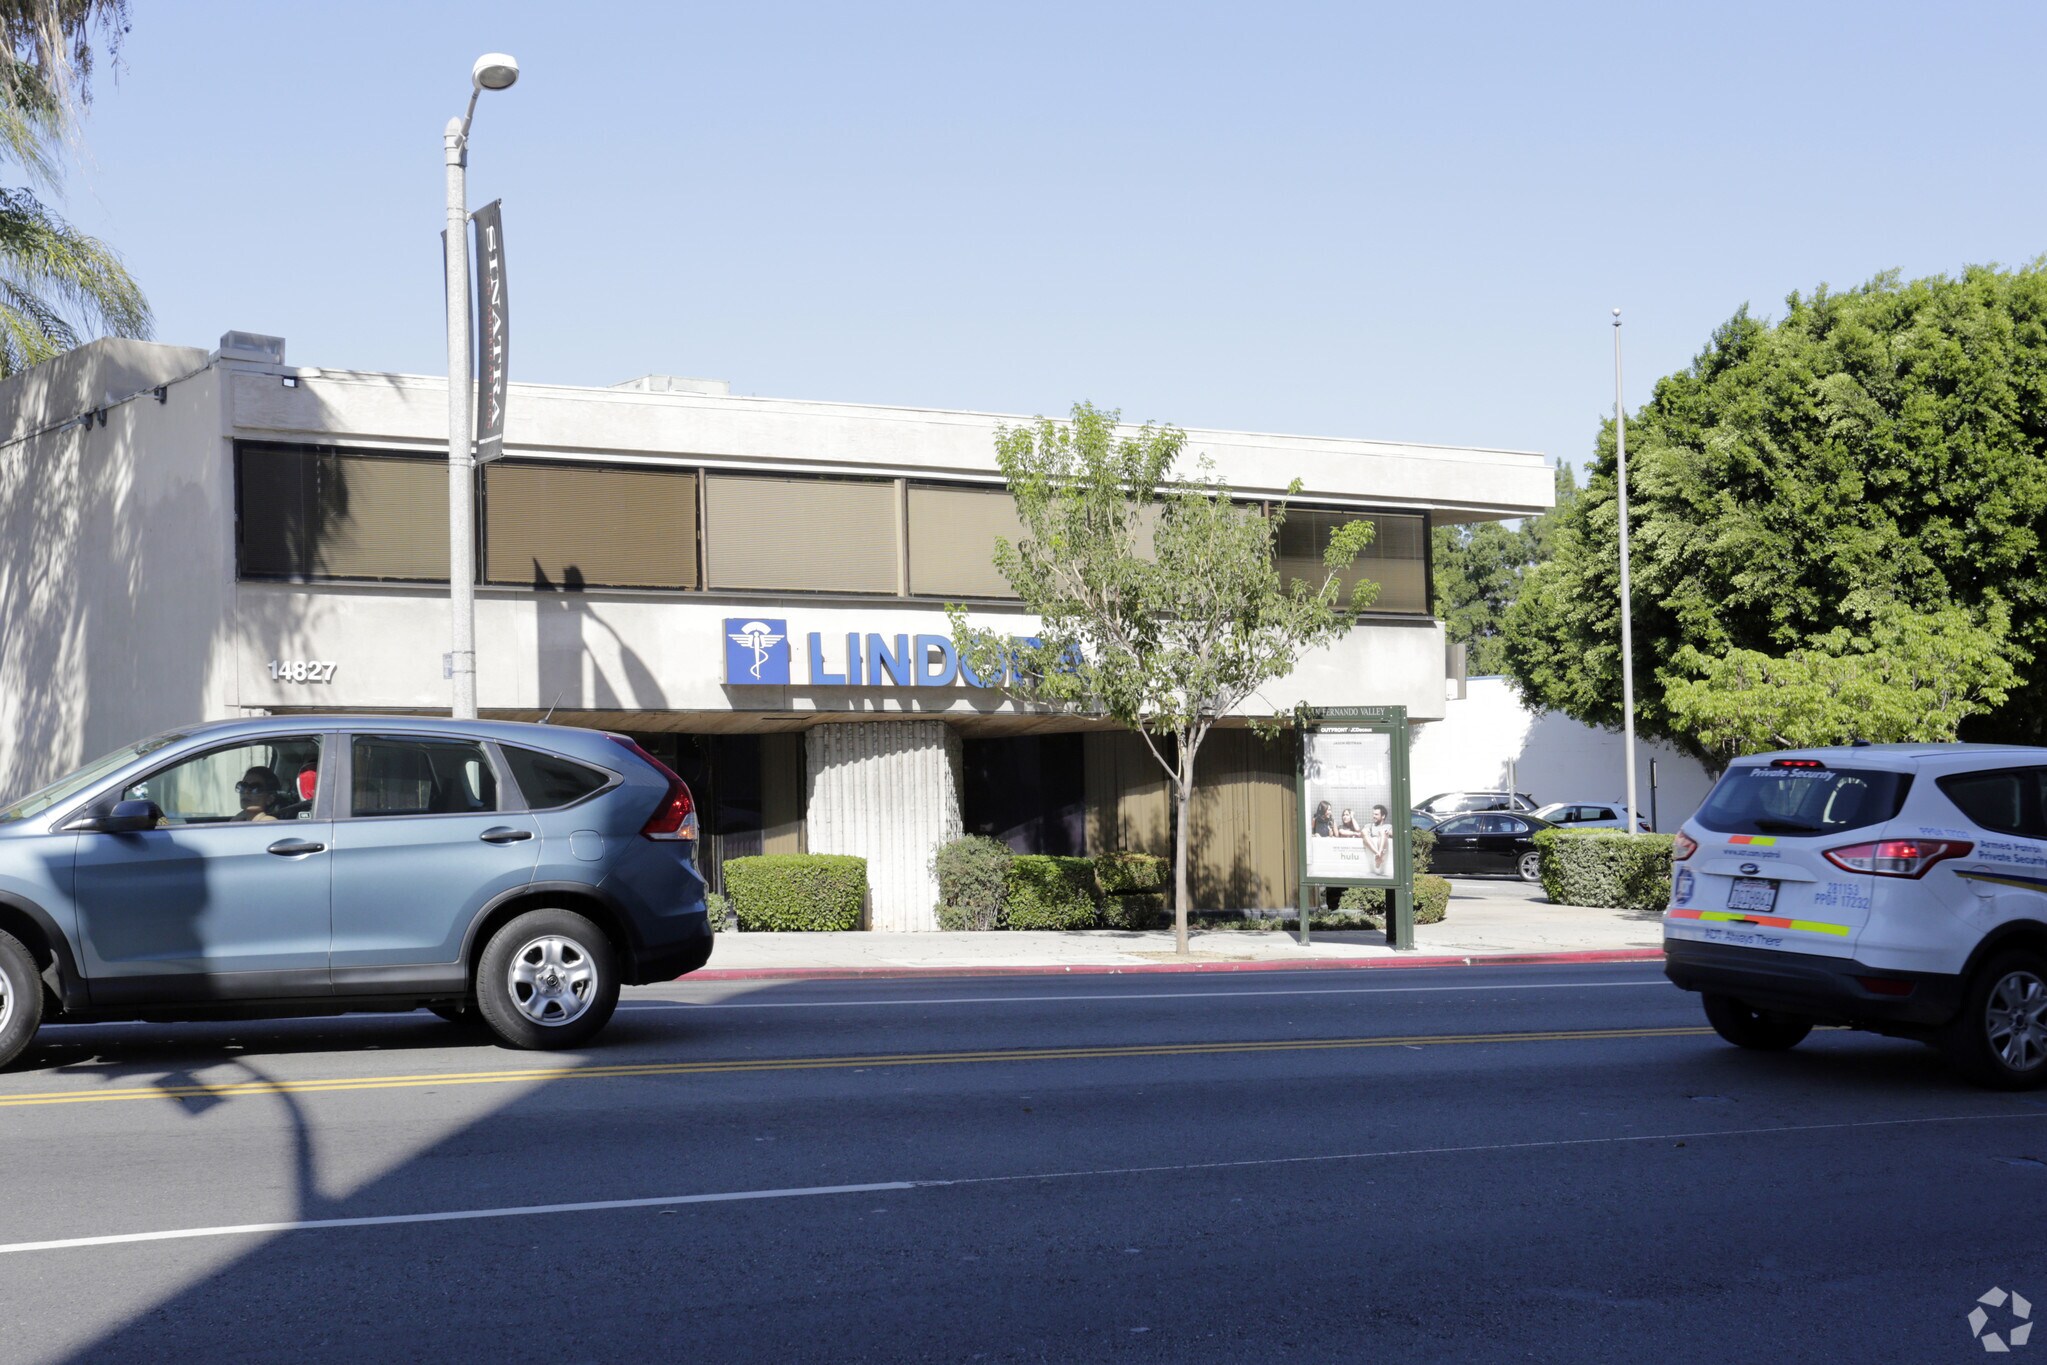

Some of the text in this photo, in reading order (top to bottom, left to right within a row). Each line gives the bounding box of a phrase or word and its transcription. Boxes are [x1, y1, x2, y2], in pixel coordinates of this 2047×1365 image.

[486, 225, 502, 427] SINATRA
[808, 632, 1092, 688] LINDO
[267, 660, 337, 682] 14827
[1322, 707, 1358, 717] FERNANDO
[1360, 706, 1386, 716] VALLEY
[1750, 768, 1836, 782] Private Security
[1340, 852, 1360, 861] hulu
[1978, 850, 2011, 862] Private
